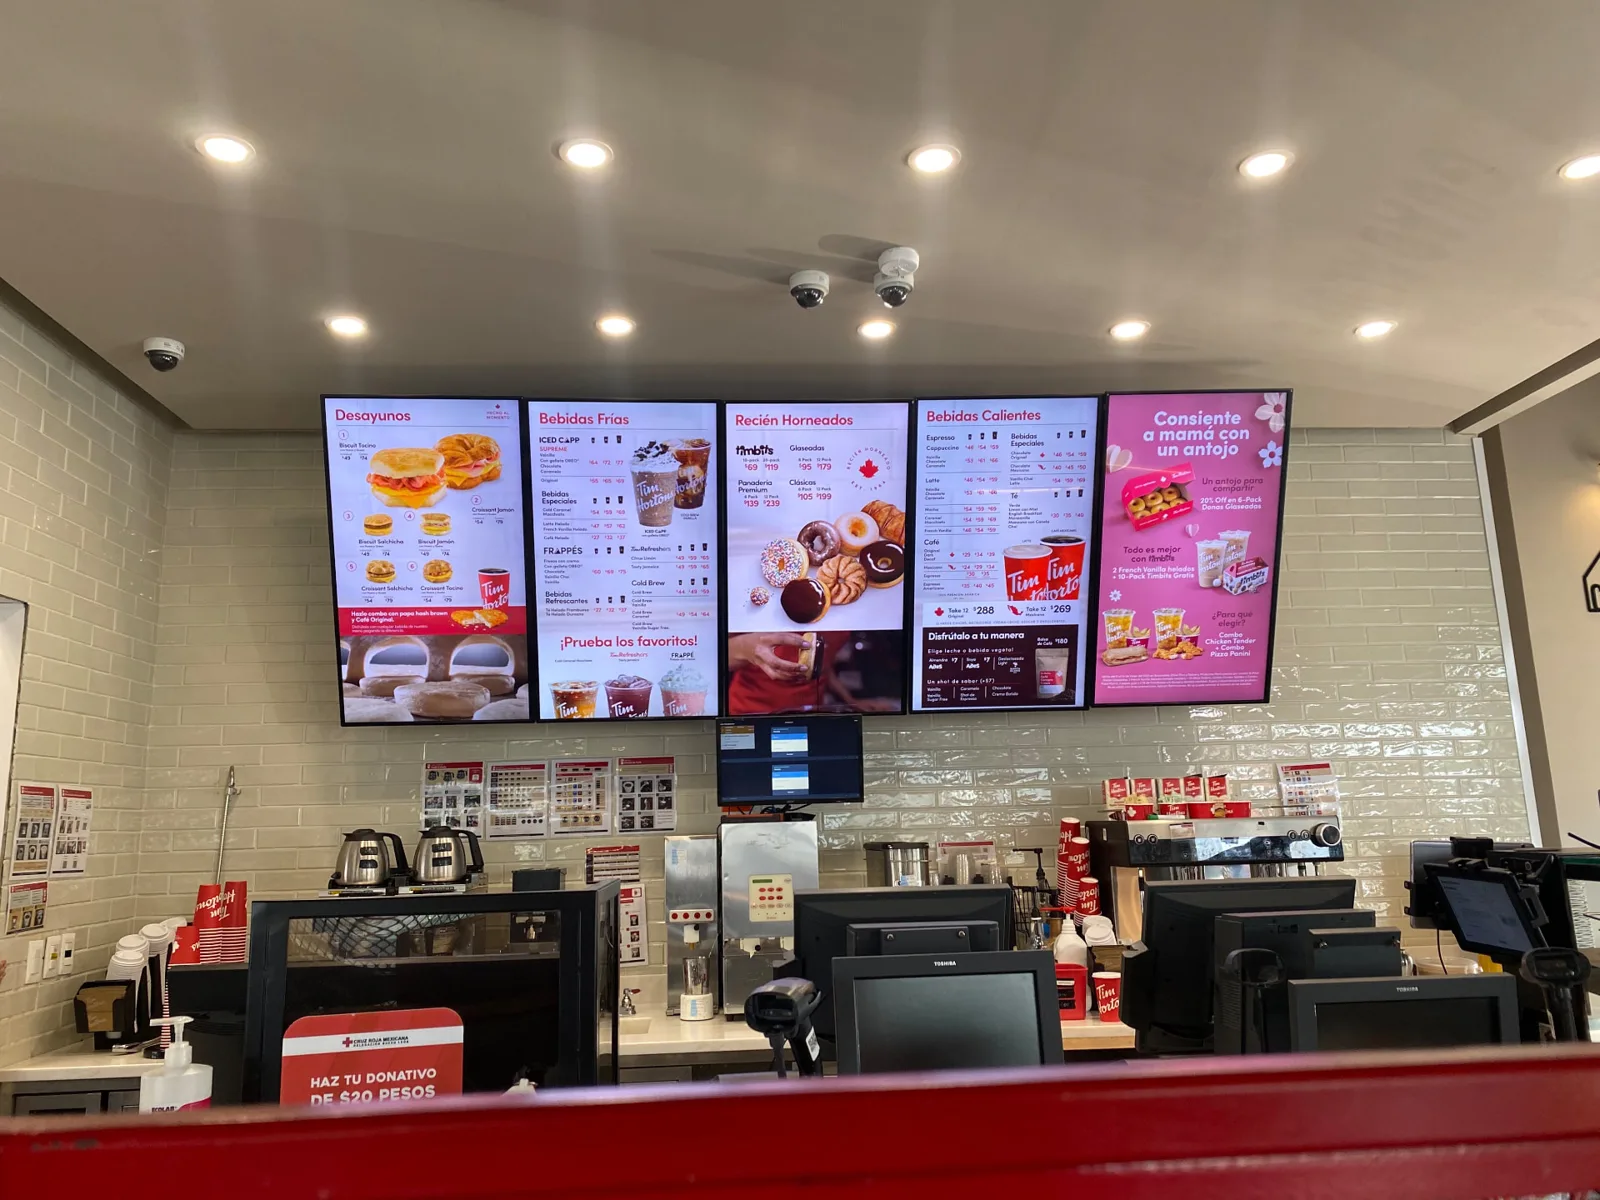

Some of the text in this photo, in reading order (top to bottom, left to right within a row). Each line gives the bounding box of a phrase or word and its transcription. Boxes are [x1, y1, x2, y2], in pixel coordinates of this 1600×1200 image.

[335, 409, 411, 424] Desayunos
[540, 413, 629, 425] Bebidas Frías
[736, 414, 853, 425] Recién Horneados
[927, 410, 1041, 422] Bebidas Calientes
[1154, 411, 1241, 426] Consiente
[1143, 426, 1250, 441] a mamá con
[736, 445, 773, 455] timbits
[1157, 441, 1239, 459] un antojo
[1213, 485, 1254, 493] compartir
[1215, 478, 1241, 487] antojo
[1244, 478, 1263, 486] para
[1157, 546, 1181, 554] mejor
[1047, 557, 1074, 581] Tim
[1007, 570, 1039, 593] Tim
[1240, 571, 1265, 584] timbits
[482, 582, 504, 598] Tim
[1050, 605, 1071, 613] $269
[1212, 611, 1236, 620] ¿Para
[560, 635, 697, 650] ¡Prueba los favoritos!
[929, 632, 970, 640] Disfrútalo
[557, 702, 577, 718] Tim
[612, 702, 634, 717] Tim
[1097, 984, 1115, 1000] Tim
[311, 1068, 436, 1088] HAZ TU DONATIVO
[311, 1085, 436, 1106] DE $20 PESOS
